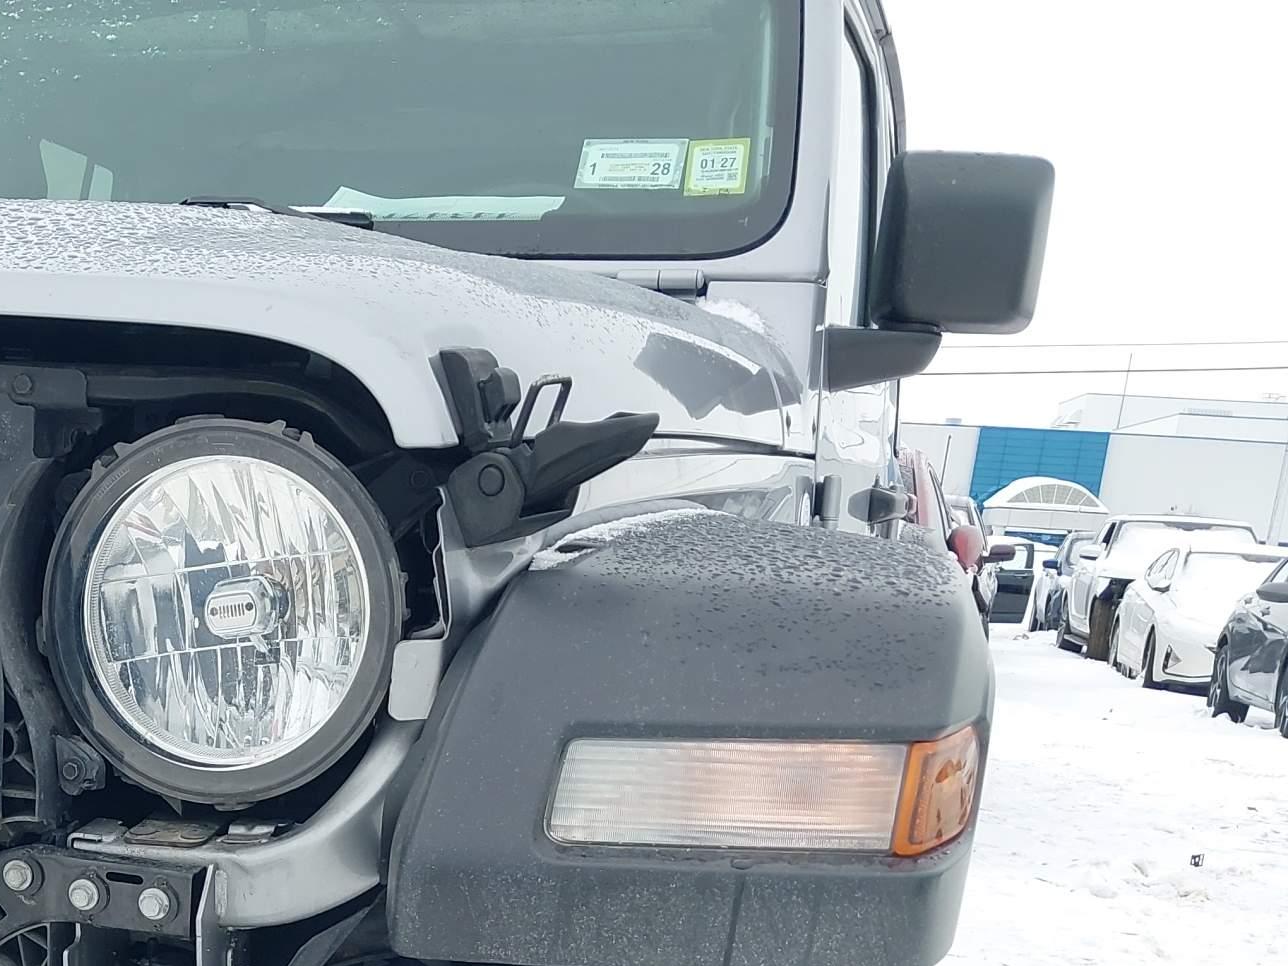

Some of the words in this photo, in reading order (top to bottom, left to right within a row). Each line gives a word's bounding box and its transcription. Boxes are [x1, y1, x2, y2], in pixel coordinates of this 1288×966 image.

[589, 162, 597, 176] 1
[650, 162, 671, 176] 28
[700, 158, 715, 170] 01
[720, 157, 737, 168] 27
